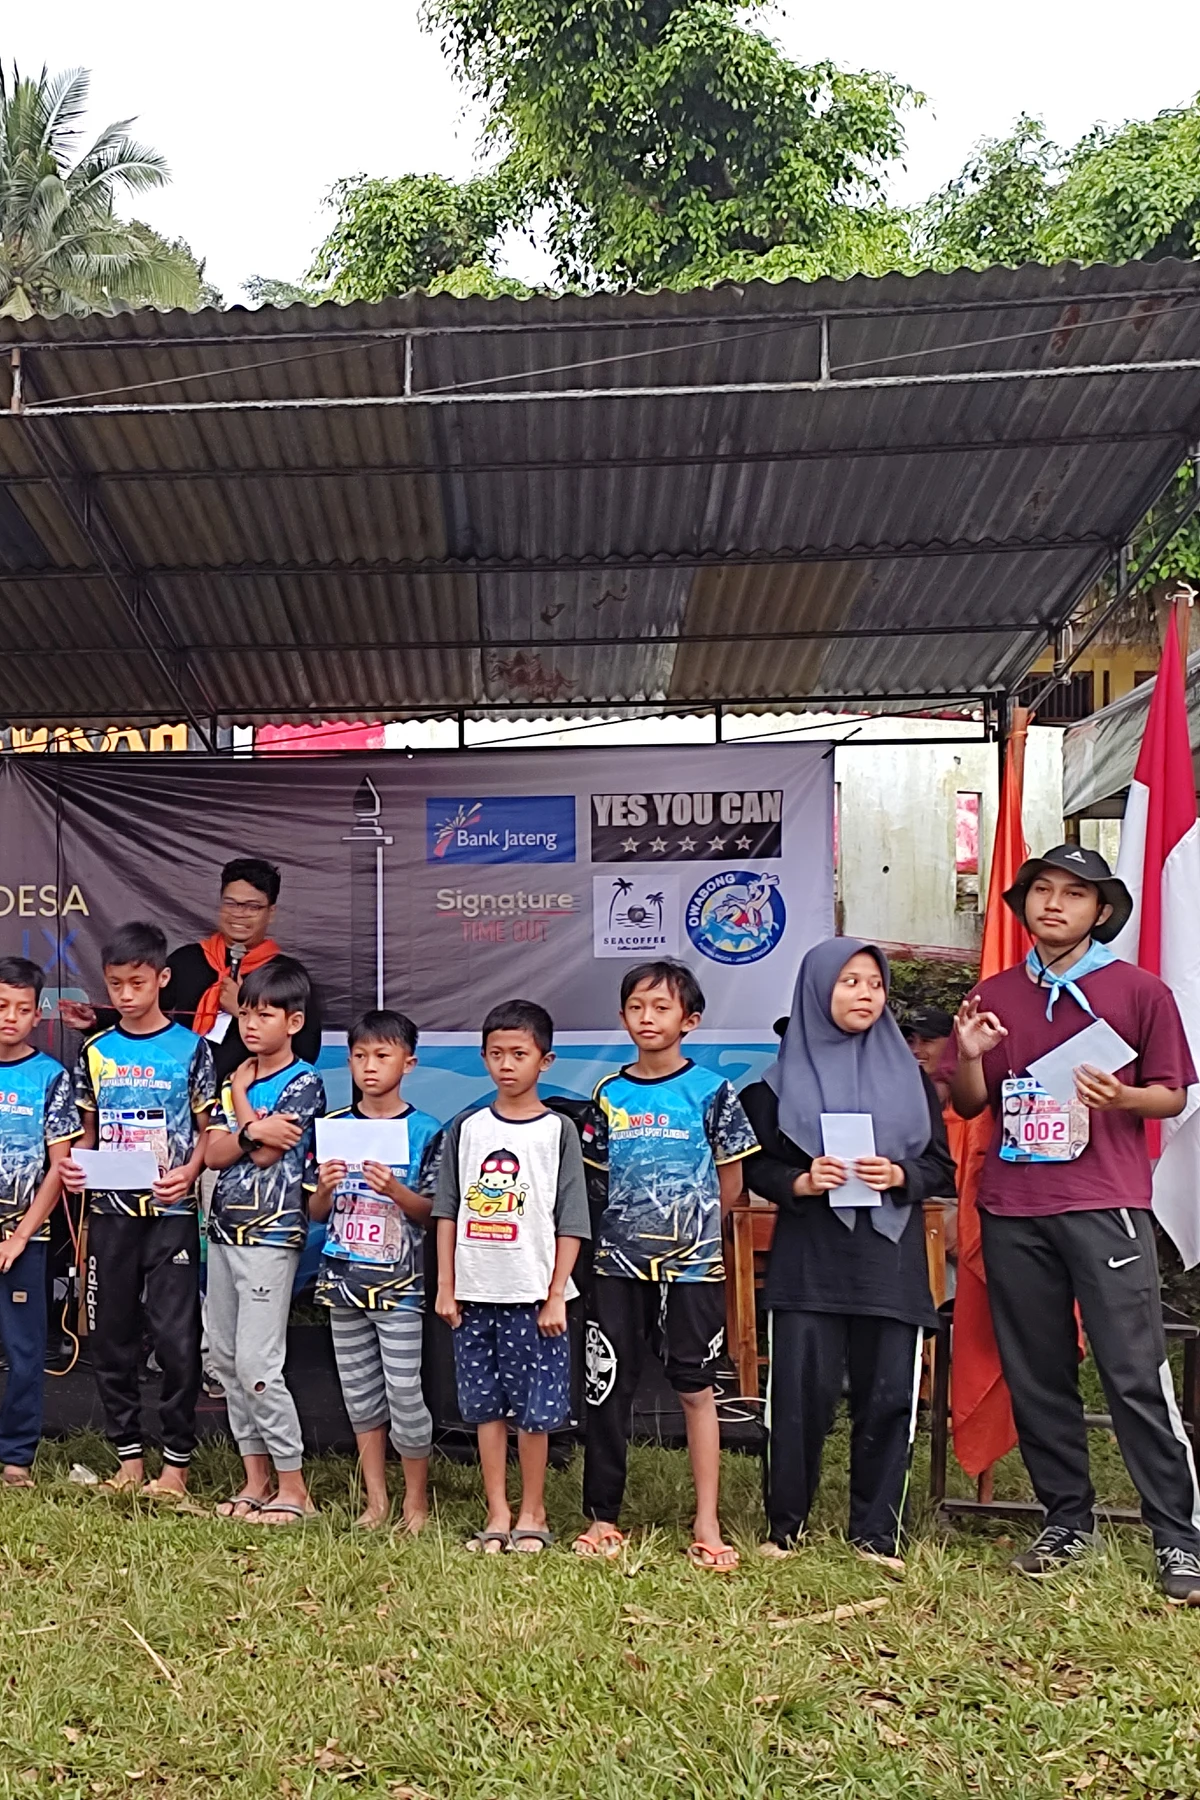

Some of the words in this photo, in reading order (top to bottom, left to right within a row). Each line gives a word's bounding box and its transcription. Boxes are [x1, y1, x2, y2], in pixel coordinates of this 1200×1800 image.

[593, 794, 648, 827] YES
[654, 792, 714, 825] YOU
[720, 790, 783, 825] CAN
[457, 829, 500, 847] Bank
[502, 830, 558, 851] Jateng
[436, 888, 574, 918] Signature
[688, 873, 736, 927] OWABONG
[460, 920, 507, 943] TIME
[512, 920, 550, 943] OUT
[603, 936, 667, 945] SEACOFFEE
[1024, 1121, 1065, 1141] 002
[346, 1222, 381, 1243] 012
[86, 1255, 98, 1331] adidas
